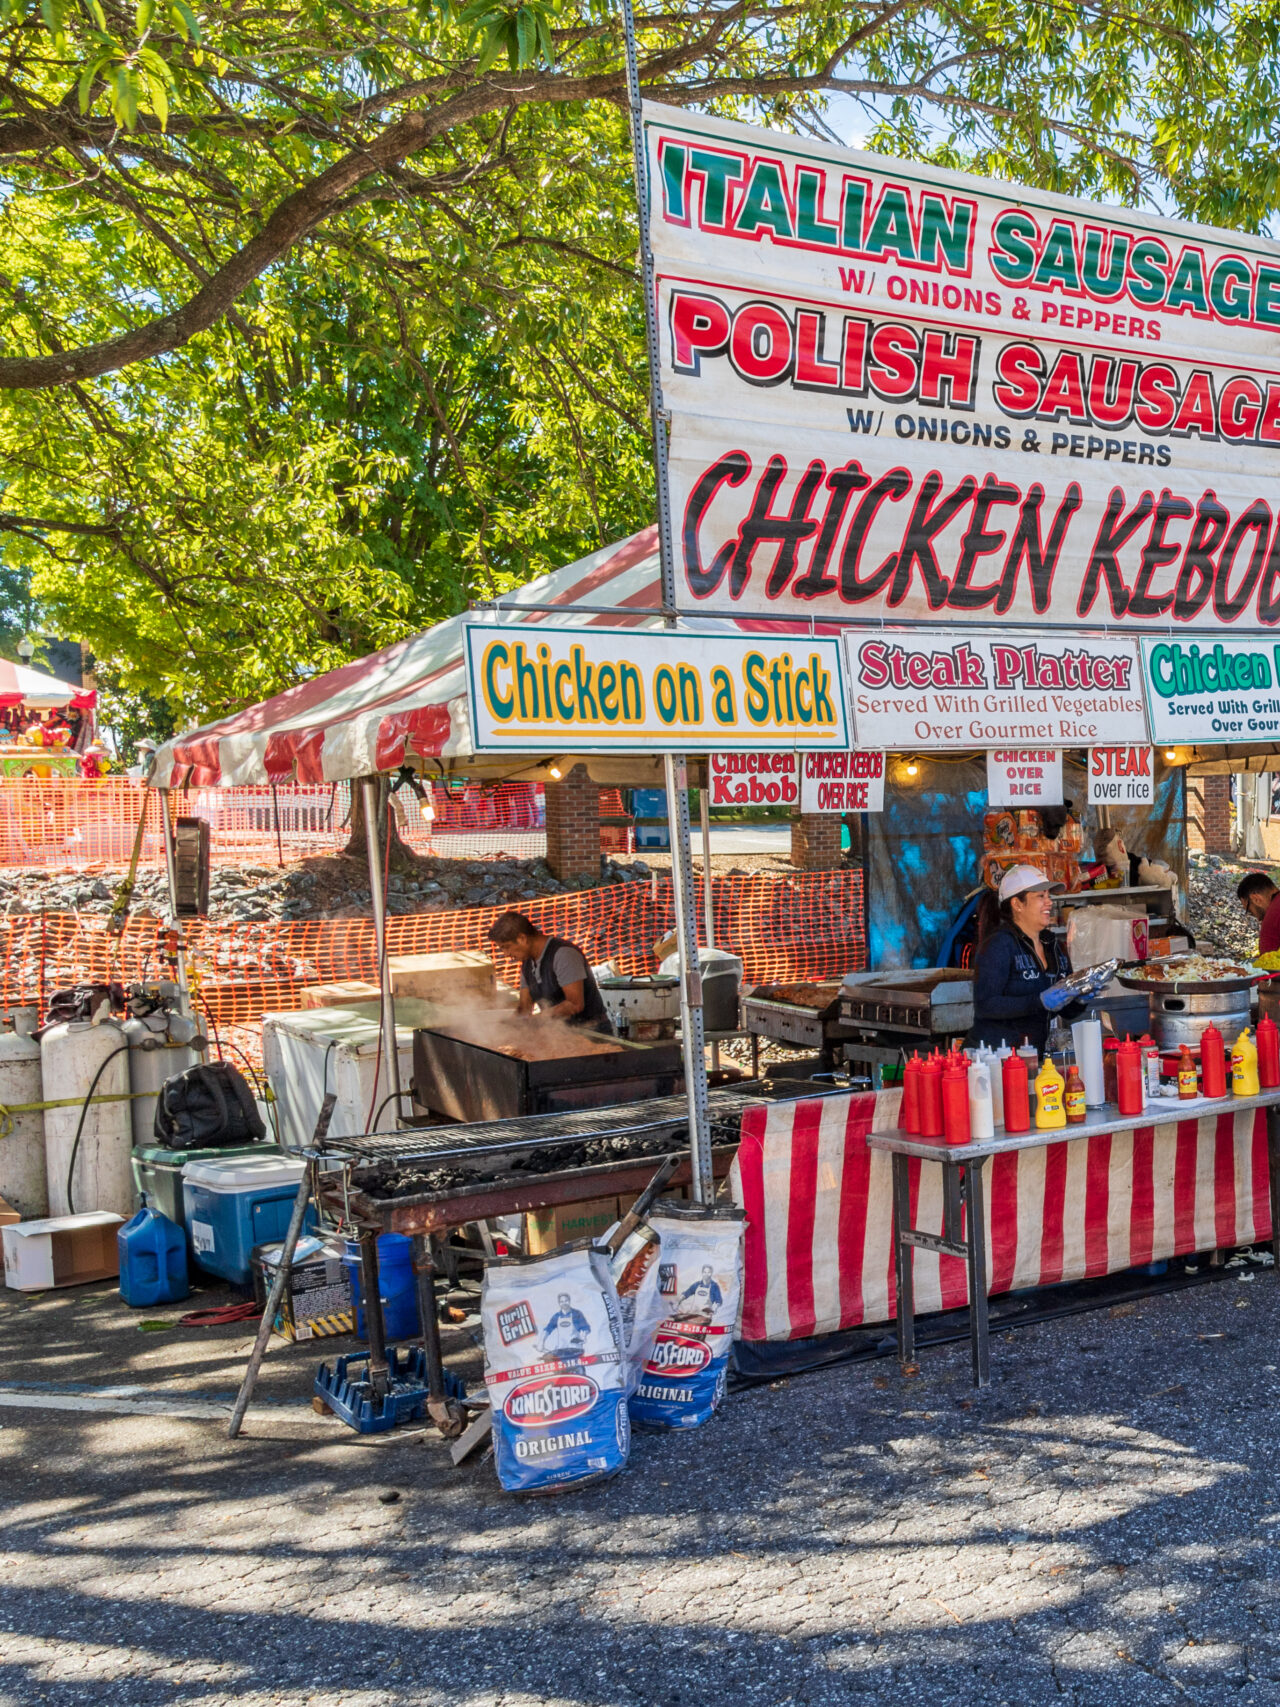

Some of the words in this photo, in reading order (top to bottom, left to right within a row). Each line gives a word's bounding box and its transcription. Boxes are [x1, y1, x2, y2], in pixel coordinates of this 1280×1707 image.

[658, 136, 977, 278] ITALIAN
[839, 267, 875, 294] W/
[887, 276, 1001, 317] ONIONS
[1012, 299, 1031, 321] &
[1041, 302, 1161, 341] PEPPERS
[670, 289, 980, 411] POLISH
[846, 409, 884, 435] W/
[895, 414, 1009, 448] ONIONS
[1021, 430, 1040, 452] &
[1052, 432, 1173, 467] PEPPERS
[683, 450, 1081, 617] CHICKEN
[858, 639, 988, 691] Steak
[991, 641, 1134, 692] Platter
[1149, 641, 1273, 699] Chicken
[481, 640, 646, 725] Chicken
[653, 662, 704, 728] on
[711, 664, 738, 727] a
[742, 650, 838, 727] Stick
[857, 694, 929, 715] Served
[933, 695, 976, 715] With
[983, 695, 1049, 716] Grilled
[1051, 696, 1143, 717] Vegetables
[1168, 700, 1216, 717] Served
[1219, 699, 1249, 717] With
[914, 721, 966, 742] Over
[969, 720, 1054, 742] Gourmet
[1058, 720, 1098, 740] Rice
[1210, 717, 1243, 734] Over
[711, 753, 796, 774] Chicken
[805, 752, 848, 779] CHICKEN
[849, 752, 883, 779] KEBOB
[993, 750, 1057, 764] CHICKEN
[1091, 747, 1150, 778] STEAK
[1006, 766, 1044, 781] OVER
[712, 775, 798, 804] Kabob
[817, 782, 845, 809] OVER
[846, 782, 869, 809] RICE
[1009, 782, 1042, 797] RICE
[1093, 783, 1122, 799] over
[1126, 778, 1149, 799] rice
[561, 1214, 614, 1232] HARVEST
[500, 1304, 528, 1326] thrill
[501, 1316, 534, 1342] Grill
[507, 1366, 532, 1380] VALUE
[534, 1362, 558, 1374] SIZE
[511, 1383, 591, 1418] KINGSFORD
[515, 1431, 592, 1458] ORIGINAL
